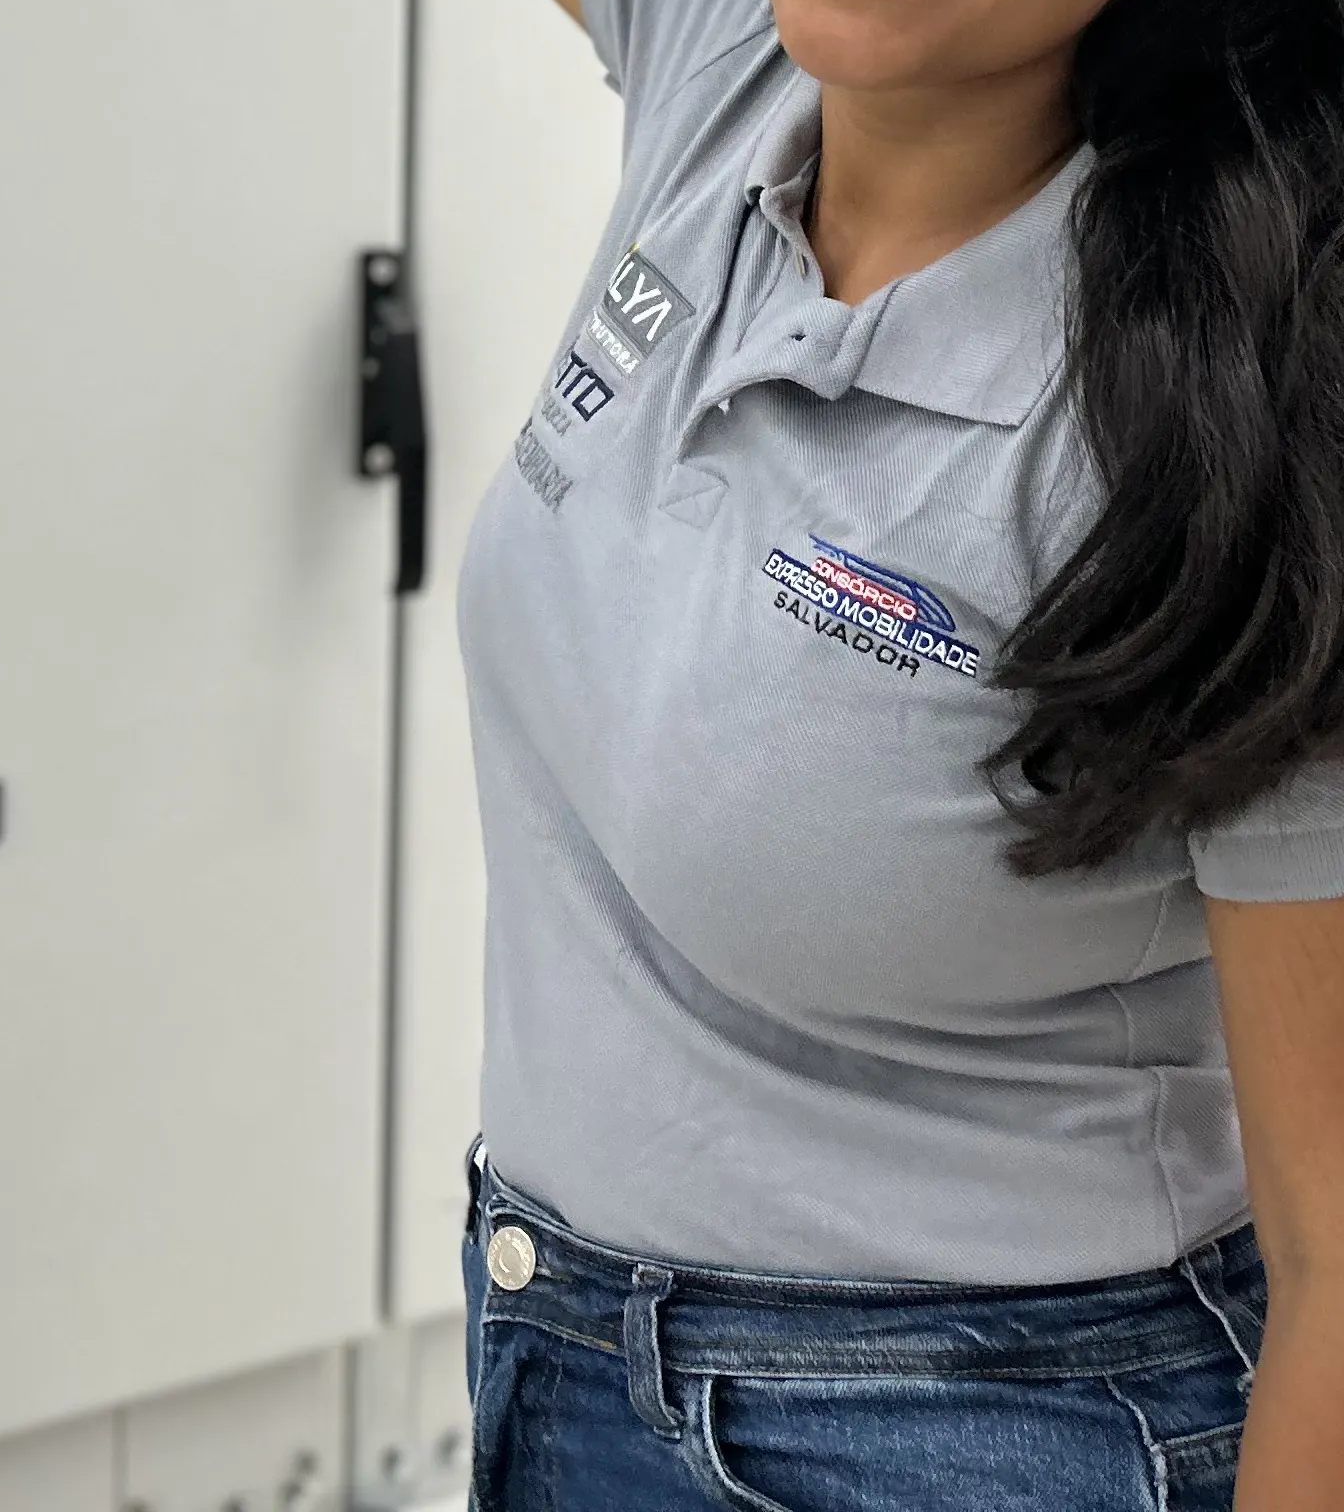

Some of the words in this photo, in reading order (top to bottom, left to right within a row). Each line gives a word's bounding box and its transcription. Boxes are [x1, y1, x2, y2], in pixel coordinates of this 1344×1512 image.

[765, 554, 839, 608] EXPRESSO
[837, 596, 980, 676] MOBILIDADE
[774, 590, 922, 678] SALVADOR
[810, 559, 919, 621] CONSÓRCIO
